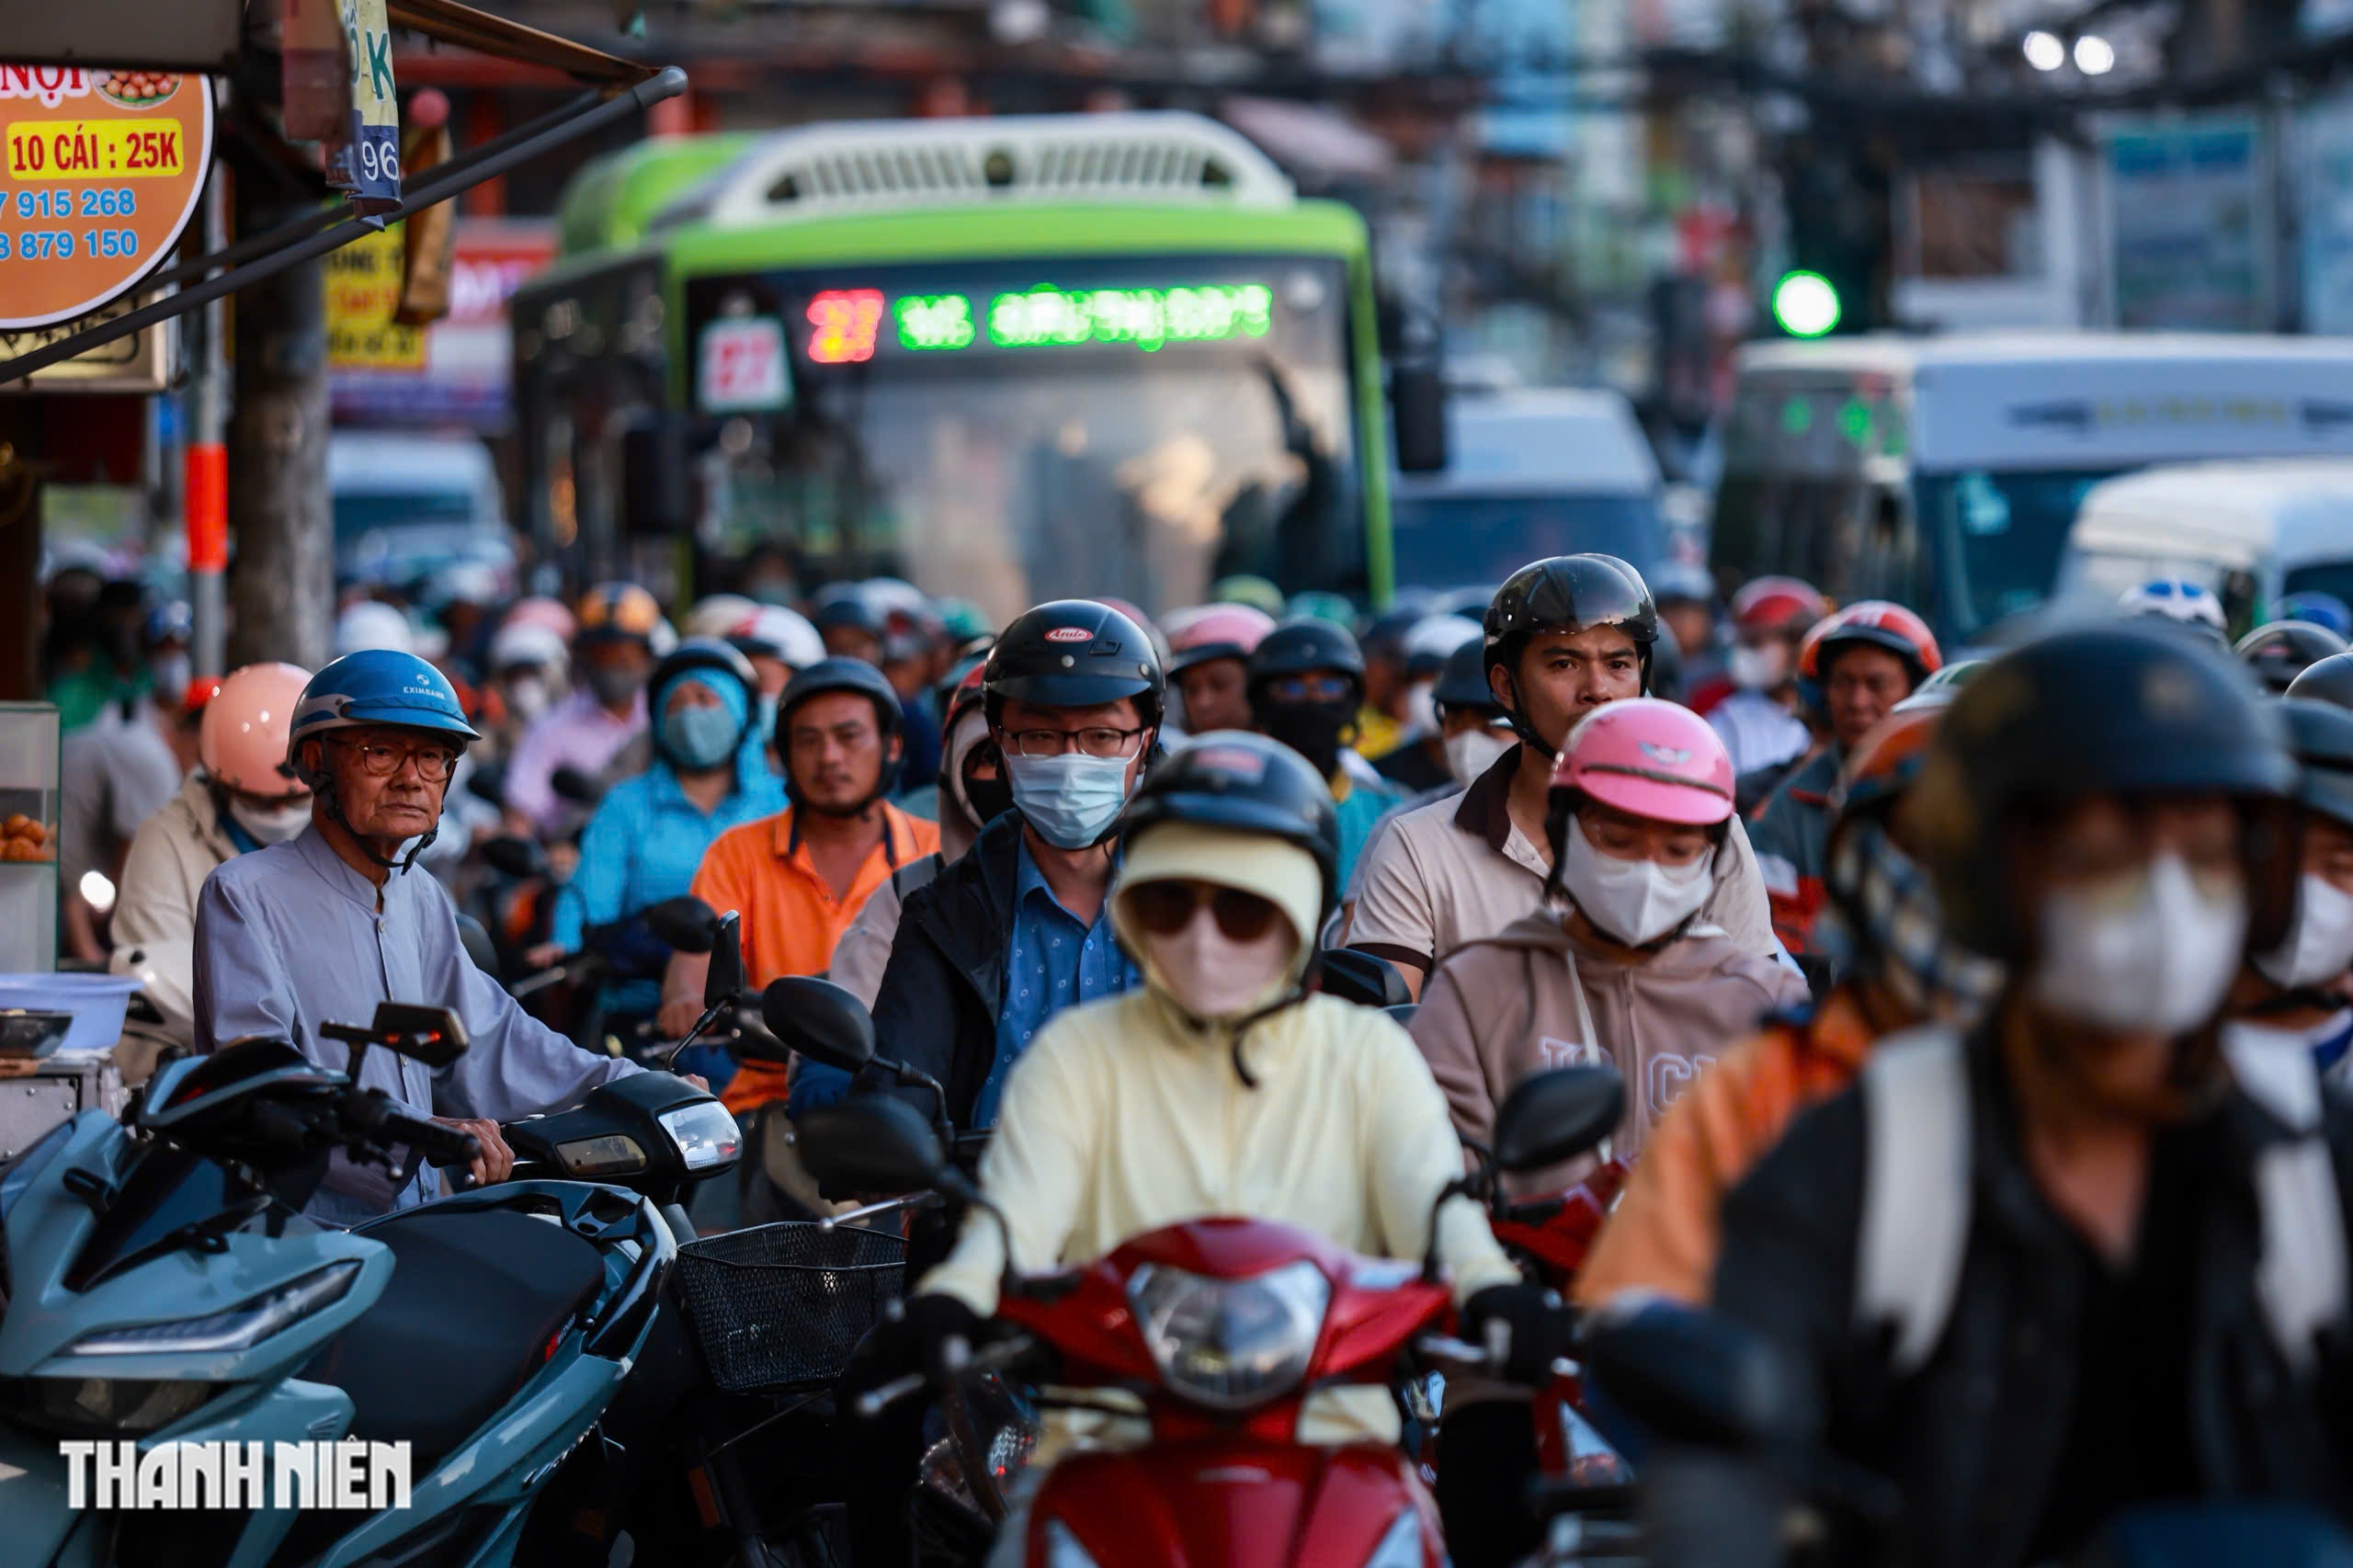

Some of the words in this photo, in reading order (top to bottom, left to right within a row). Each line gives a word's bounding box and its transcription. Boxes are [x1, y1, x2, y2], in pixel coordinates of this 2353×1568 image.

[13, 135, 44, 171] 10
[54, 124, 99, 170] CÁI
[126, 132, 178, 168] 25K
[362, 141, 398, 181] 96
[17, 190, 73, 218] 915
[81, 188, 135, 217] 268
[20, 232, 75, 260] 879
[84, 230, 138, 257] 150
[404, 687, 445, 699] EXIMBANK
